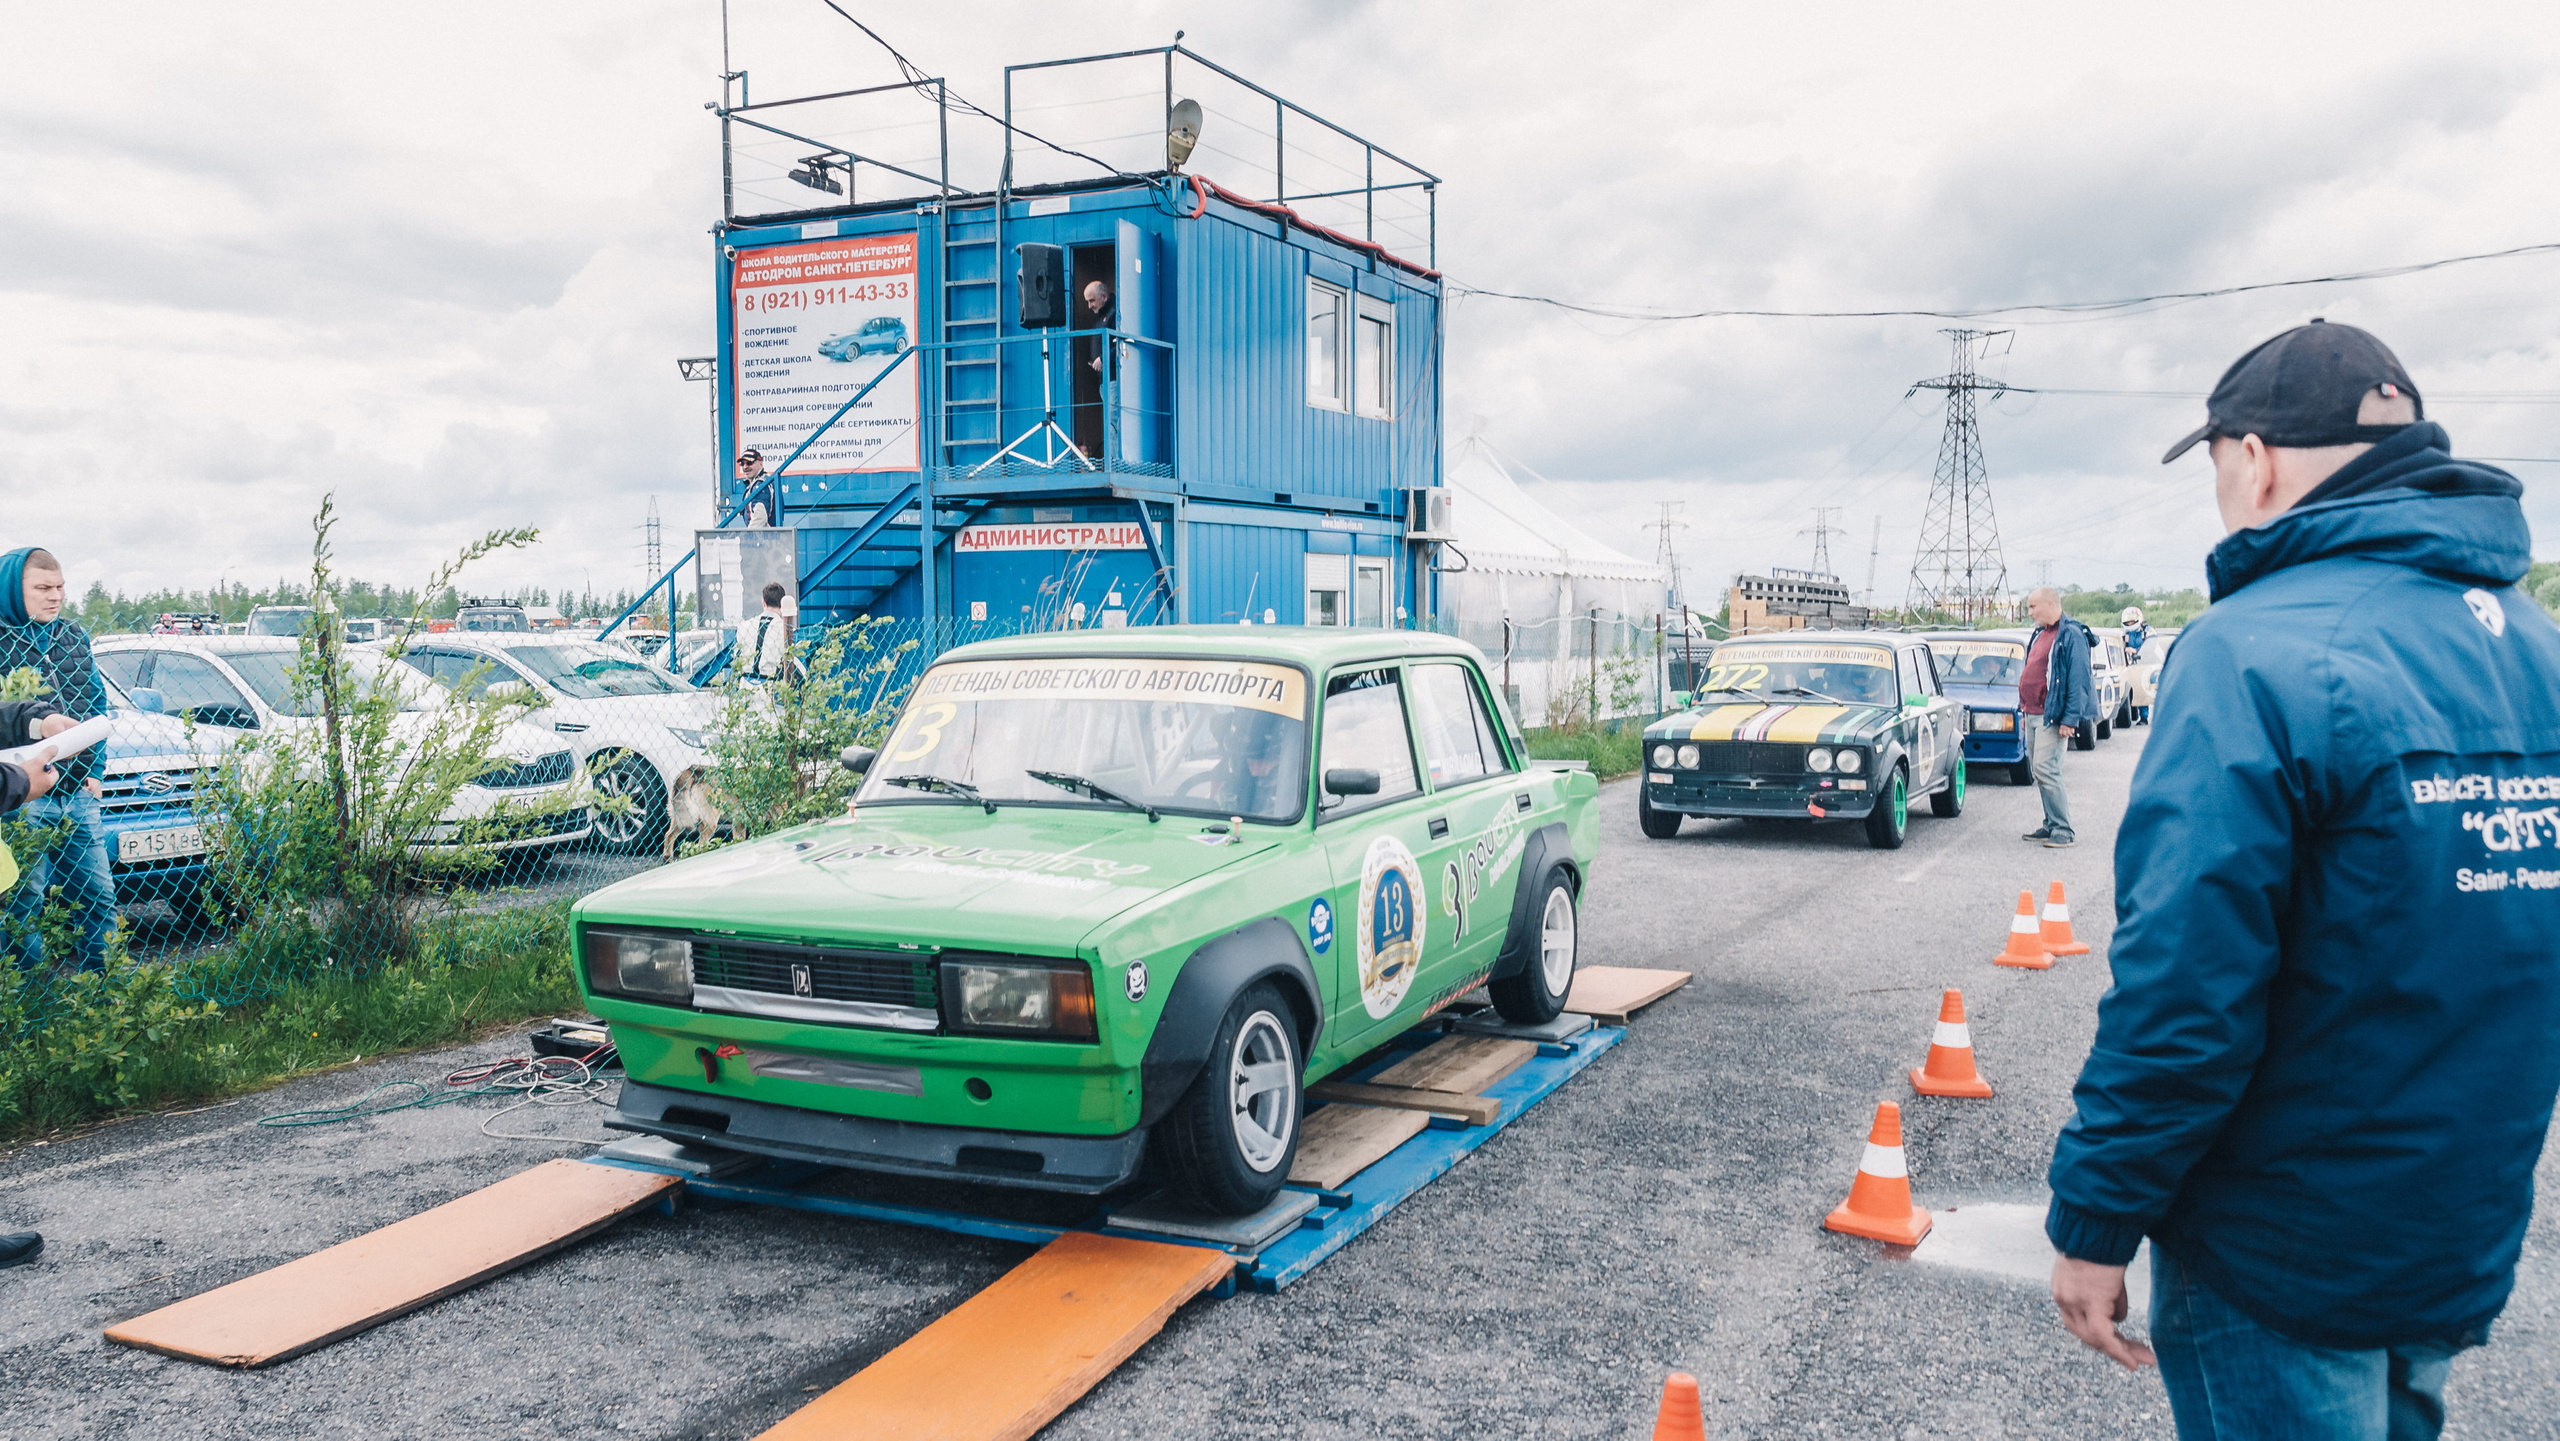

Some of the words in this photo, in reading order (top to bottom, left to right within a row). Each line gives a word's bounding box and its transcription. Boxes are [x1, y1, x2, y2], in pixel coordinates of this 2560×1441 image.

[741, 257, 772, 269] ШКОЛА
[773, 249, 849, 266] ВОДИТЕЛЬСКОГО
[851, 243, 911, 259] МАСТЕРСТВА
[740, 265, 802, 283] АВТОДРОМ
[804, 255, 912, 277] САНКТ-ПЕТЕРБУРГ
[744, 295, 755, 311] 8
[761, 290, 808, 314] (921)
[814, 281, 909, 305] 911-43-33
[744, 338, 790, 349] ВОЖДЕНИЕ
[783, 355, 812, 364] ШКОЛА
[745, 368, 790, 379] ВОЖДЕНИЯ
[848, 417, 912, 427] СЕРТИФИКАТЫ
[864, 438, 882, 447] ДЛЯ
[819, 451, 864, 460] КЛИЕНТОВ
[961, 527, 1155, 550] АДМИНИСТРАЦИ
[1716, 650, 1760, 662] ЛЕГЕНДЫ
[1761, 649, 1821, 660] СОВЕТСКОГО
[1822, 650, 1885, 664] АВТОСПОРТА
[919, 670, 1010, 698] ЛЕГЕНДЫ
[1012, 668, 1138, 690] СОВЕТСКОГО
[1142, 669, 1286, 703] АВТОСПОРТА
[1699, 663, 1769, 693] 272
[880, 701, 957, 766] 13
[1381, 881, 1404, 937] 13
